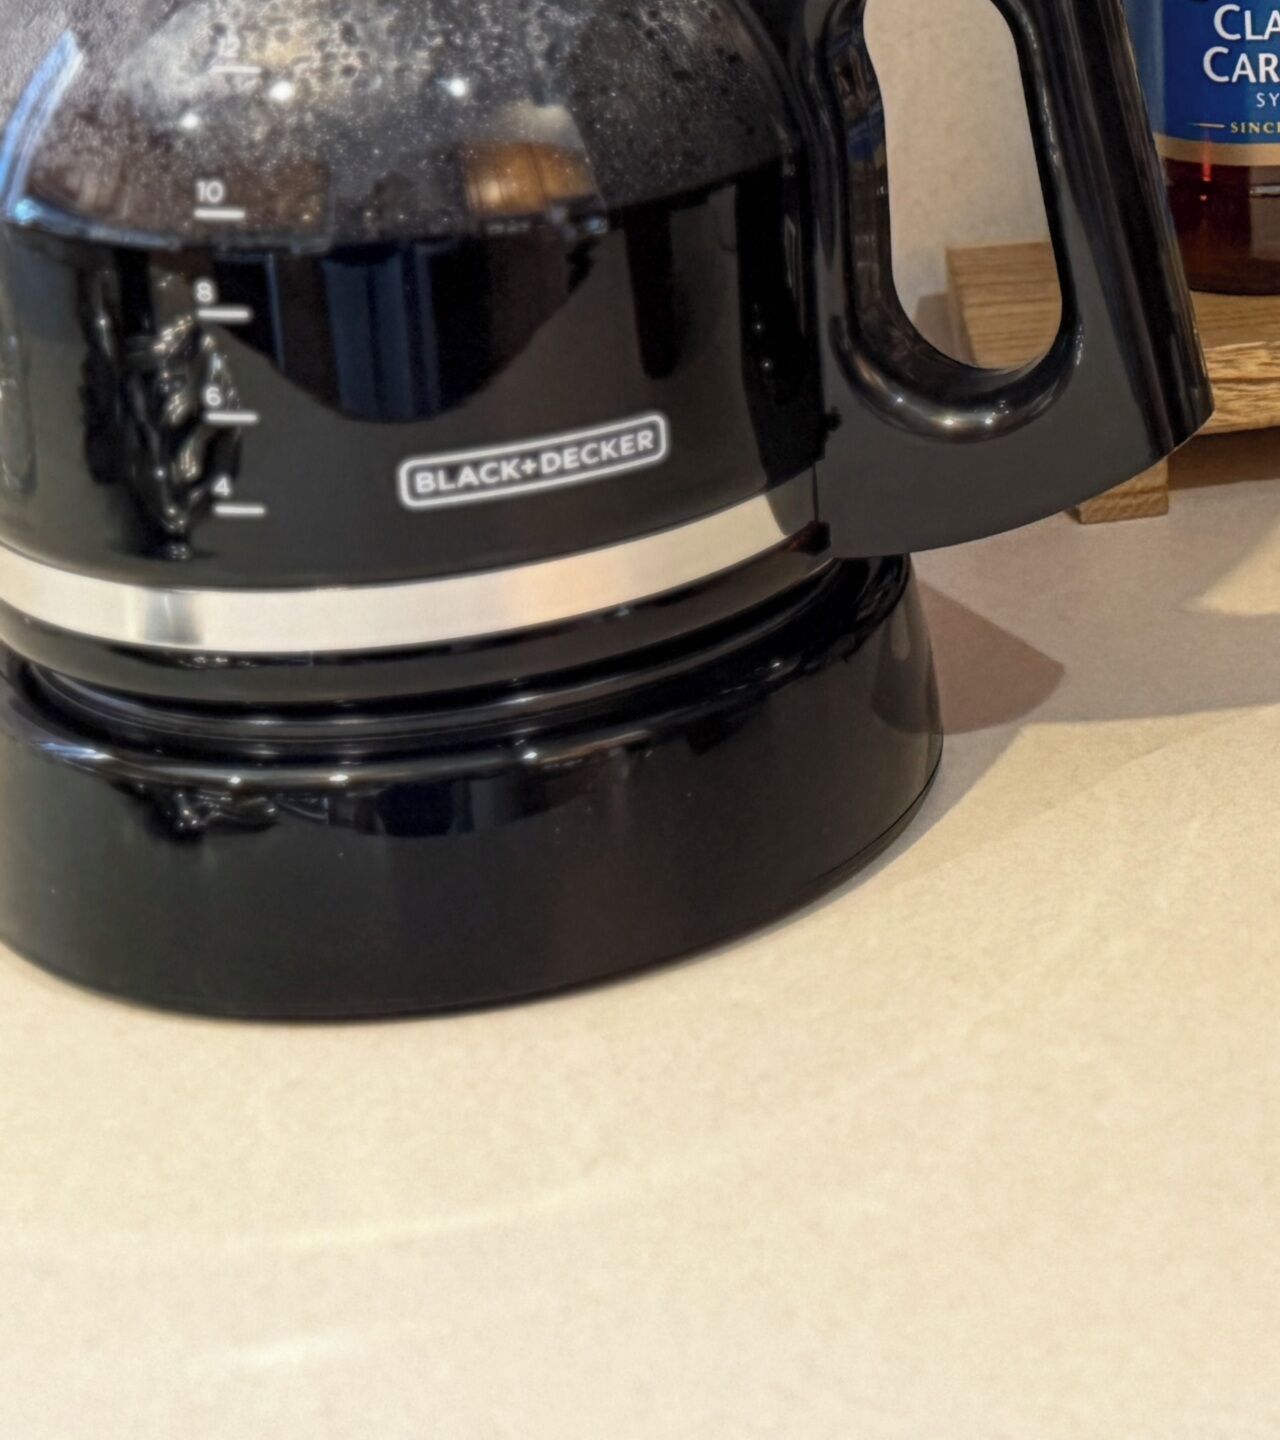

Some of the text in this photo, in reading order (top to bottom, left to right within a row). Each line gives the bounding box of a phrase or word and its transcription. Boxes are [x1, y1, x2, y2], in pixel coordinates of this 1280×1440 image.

[196, 181, 224, 203] 10
[195, 281, 214, 304] 8
[205, 386, 222, 407] 6
[414, 429, 655, 494] BLACK+DECKER
[213, 477, 231, 497] 4
